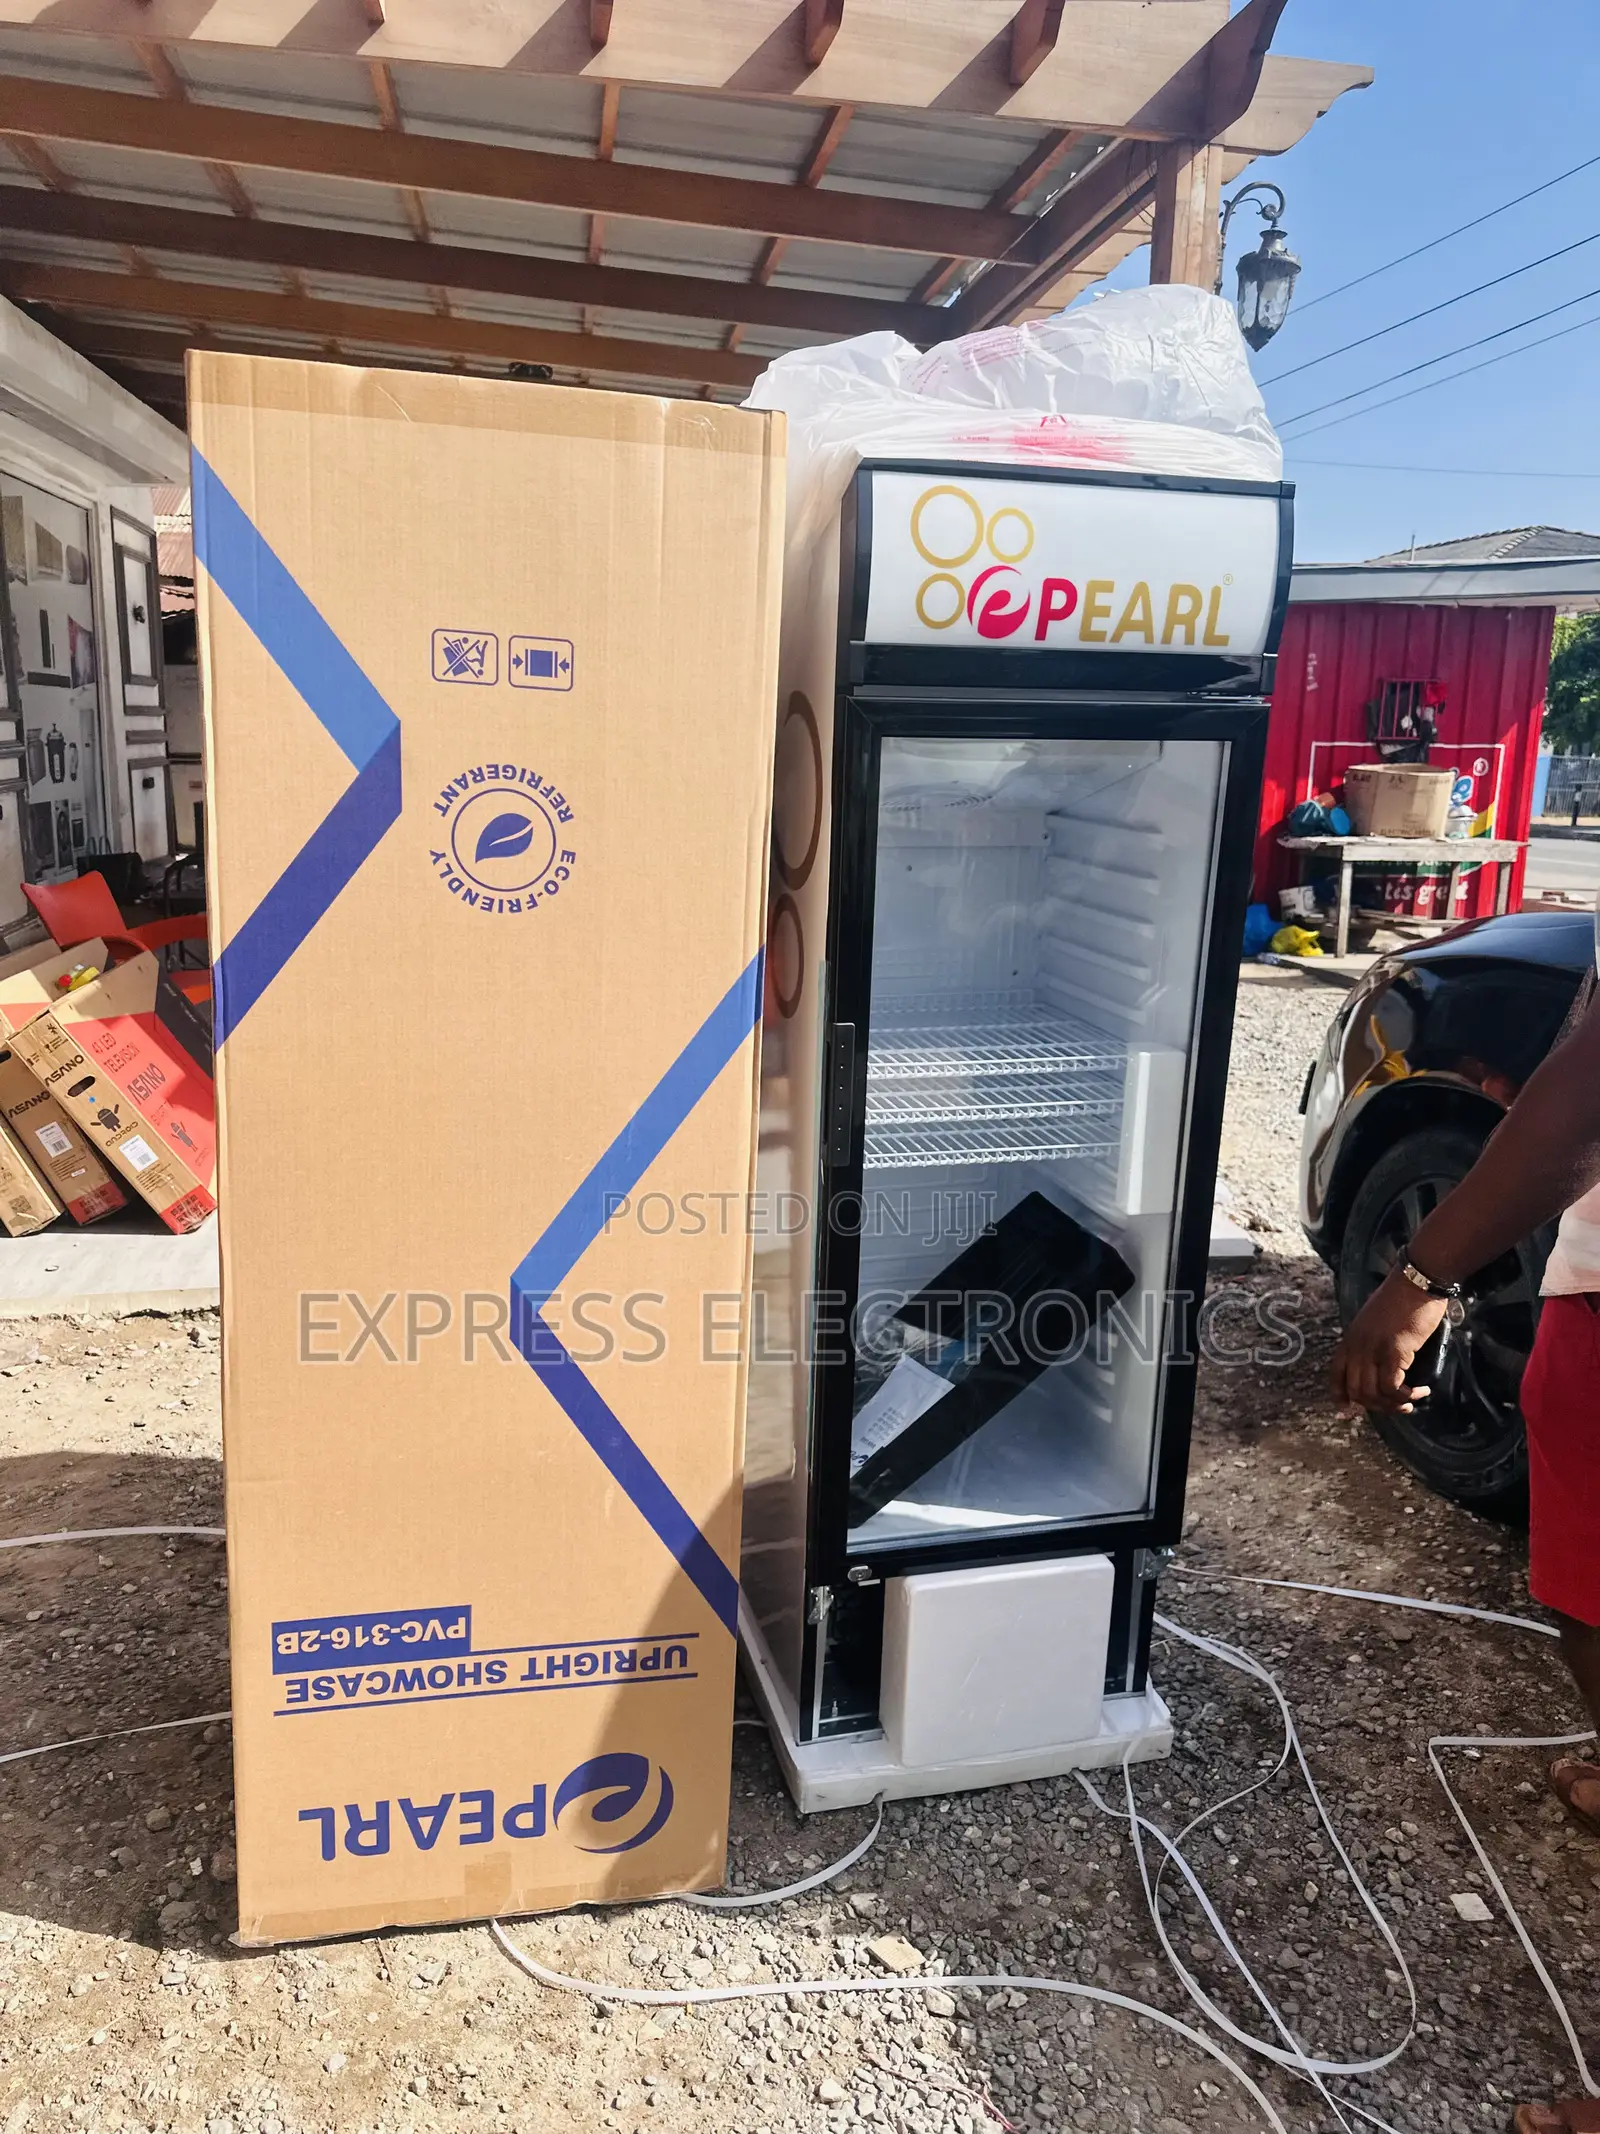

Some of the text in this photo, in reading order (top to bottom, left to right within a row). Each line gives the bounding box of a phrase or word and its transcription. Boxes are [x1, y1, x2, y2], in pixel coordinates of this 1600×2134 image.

[1034, 577, 1230, 647] PEARL
[432, 763, 575, 824] REFRIGERANT
[429, 849, 577, 914] ECO-FRIENDLY
[44, 1054, 84, 1087] ASANO
[104, 1042, 140, 1074] TELEVISION
[127, 1062, 166, 1105] ASANO
[7, 1090, 51, 1118] ASANO
[276, 1616, 466, 1655] PVC-316-2B
[285, 1645, 689, 1704] UPRIGHT SHOWCASE
[299, 1783, 547, 1861] PEARL
